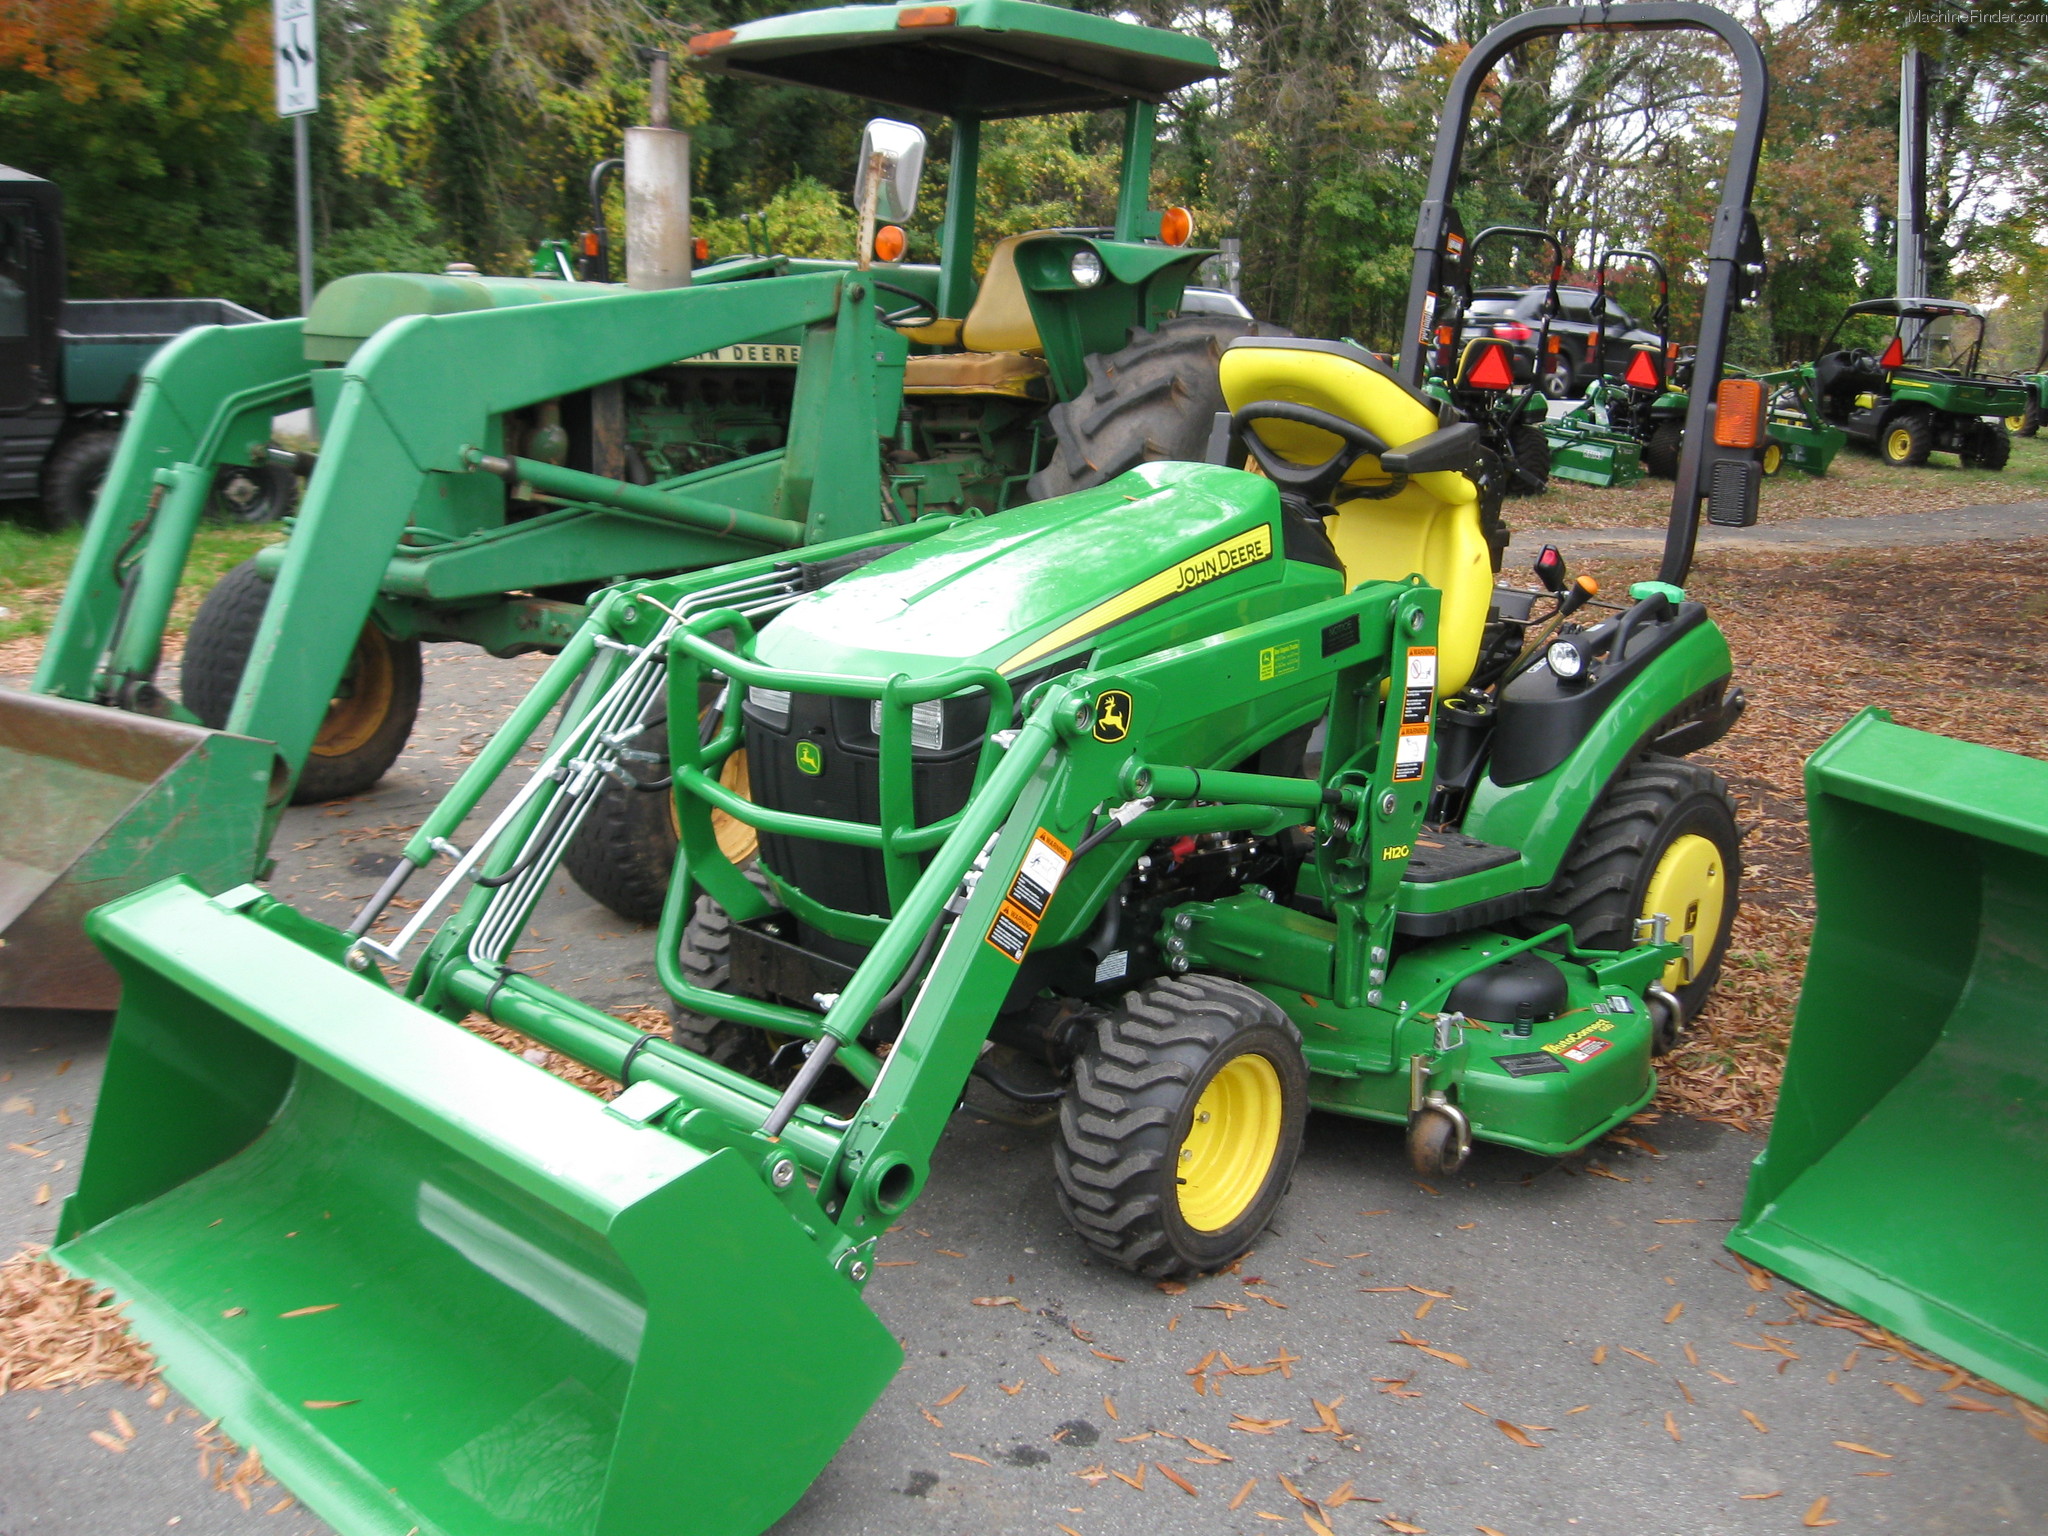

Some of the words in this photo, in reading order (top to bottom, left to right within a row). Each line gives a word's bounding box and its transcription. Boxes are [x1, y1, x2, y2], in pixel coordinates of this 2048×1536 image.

[733, 346, 799, 362] DEERE
[1176, 557, 1217, 590] JOHN
[1218, 540, 1264, 570] DEERE
[1413, 648, 1436, 656] WARNING
[1405, 727, 1428, 736] WARNING
[1045, 836, 1068, 858] WARNING
[1010, 910, 1033, 931] WARNING
[1549, 1018, 1610, 1054] AutoConnect
